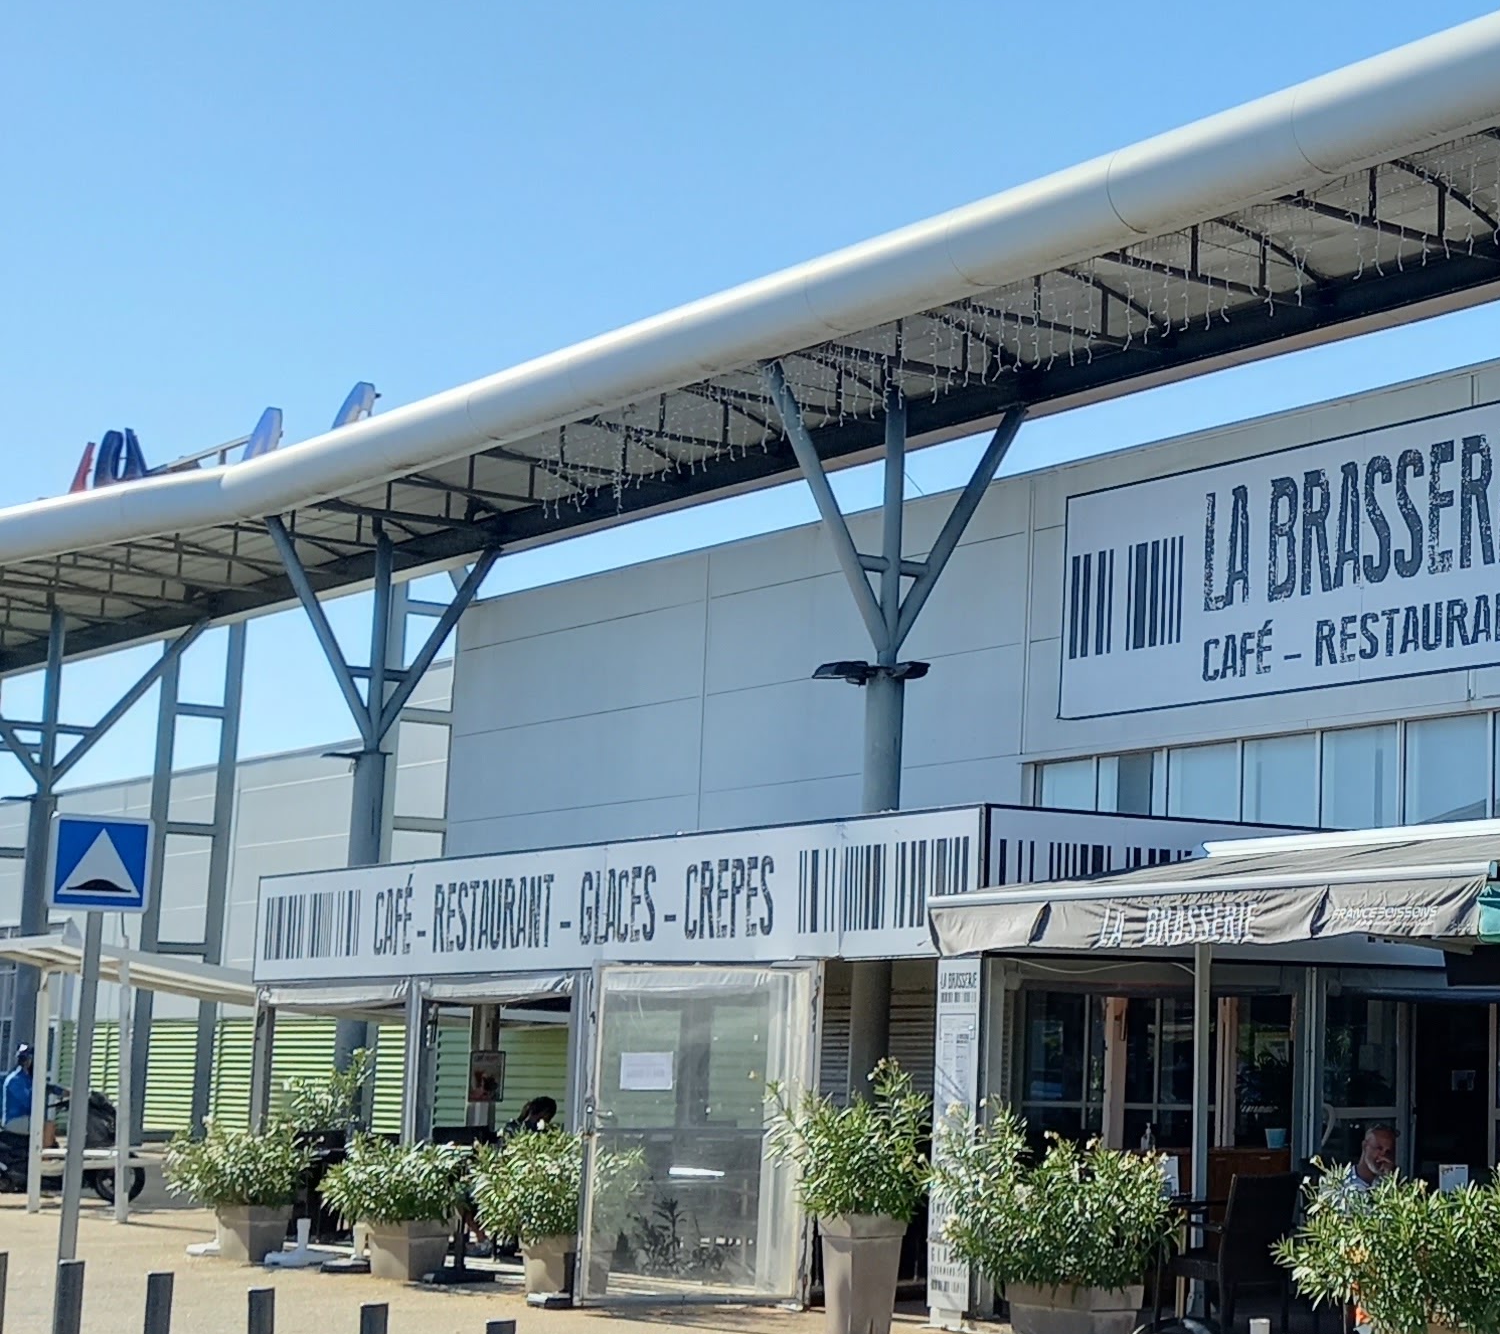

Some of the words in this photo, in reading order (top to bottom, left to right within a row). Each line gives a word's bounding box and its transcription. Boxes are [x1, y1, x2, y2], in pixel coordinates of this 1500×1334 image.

[1203, 484, 1249, 612] LA
[1202, 619, 1274, 682] CAFÉ
[373, 872, 415, 956] CAFÉ
[432, 873, 555, 953] RESTAURANT
[579, 865, 657, 946] GLACES
[684, 855, 775, 941] CREPES
[1142, 900, 1259, 947] BRASSERIE
